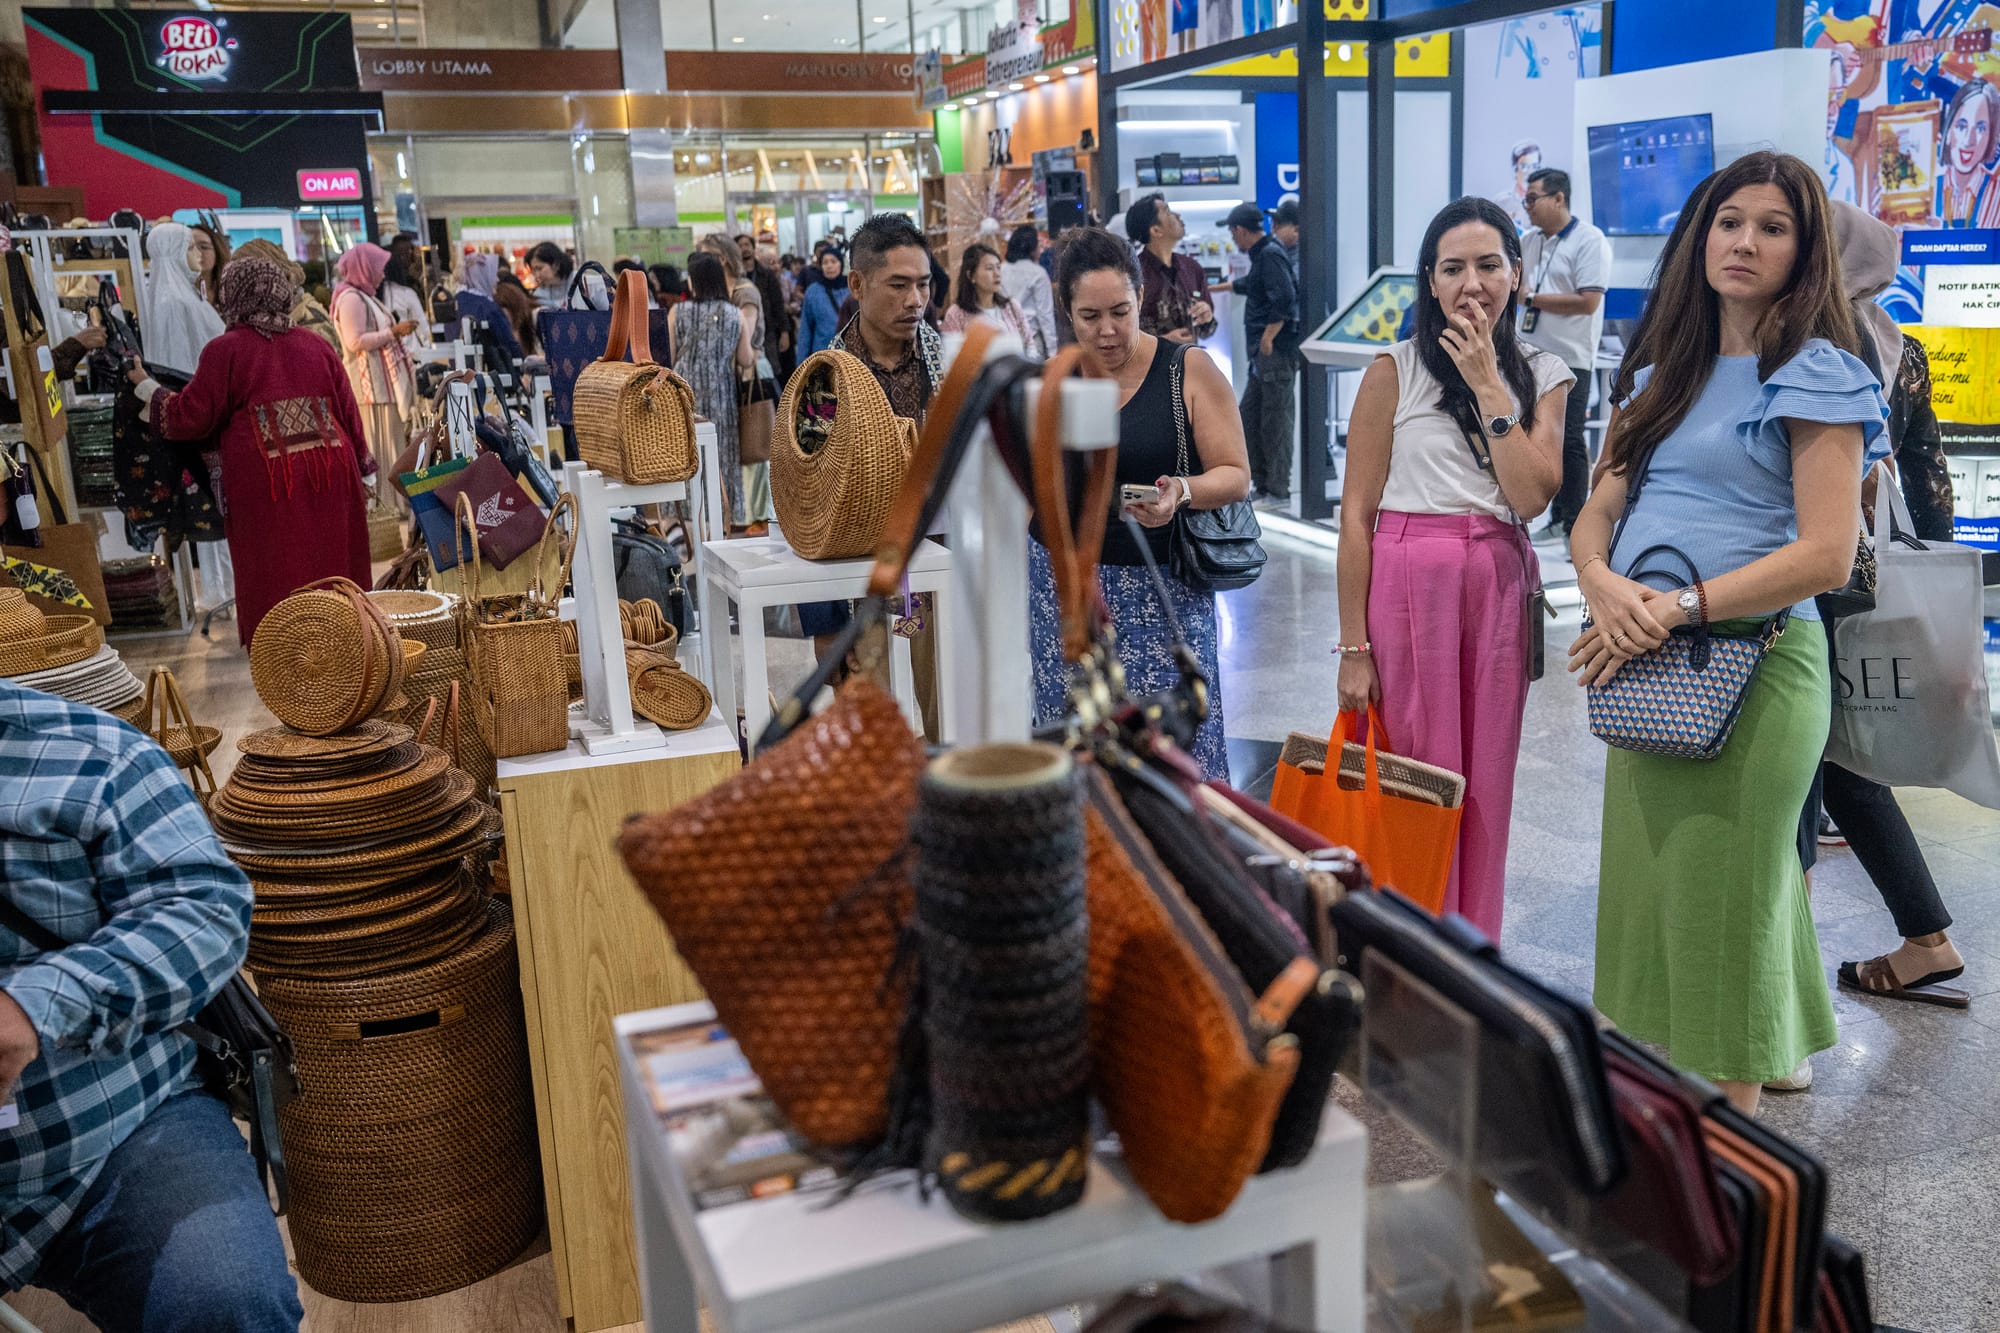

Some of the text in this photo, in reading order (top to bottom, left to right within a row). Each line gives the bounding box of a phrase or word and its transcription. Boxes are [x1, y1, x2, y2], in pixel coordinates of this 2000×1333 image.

[173, 49, 226, 74] LOKAL
[372, 60, 492, 75] LOBBY UTAMA
[305, 176, 355, 191] ON AIR
[1938, 282, 2000, 291] MOTIF BATIK
